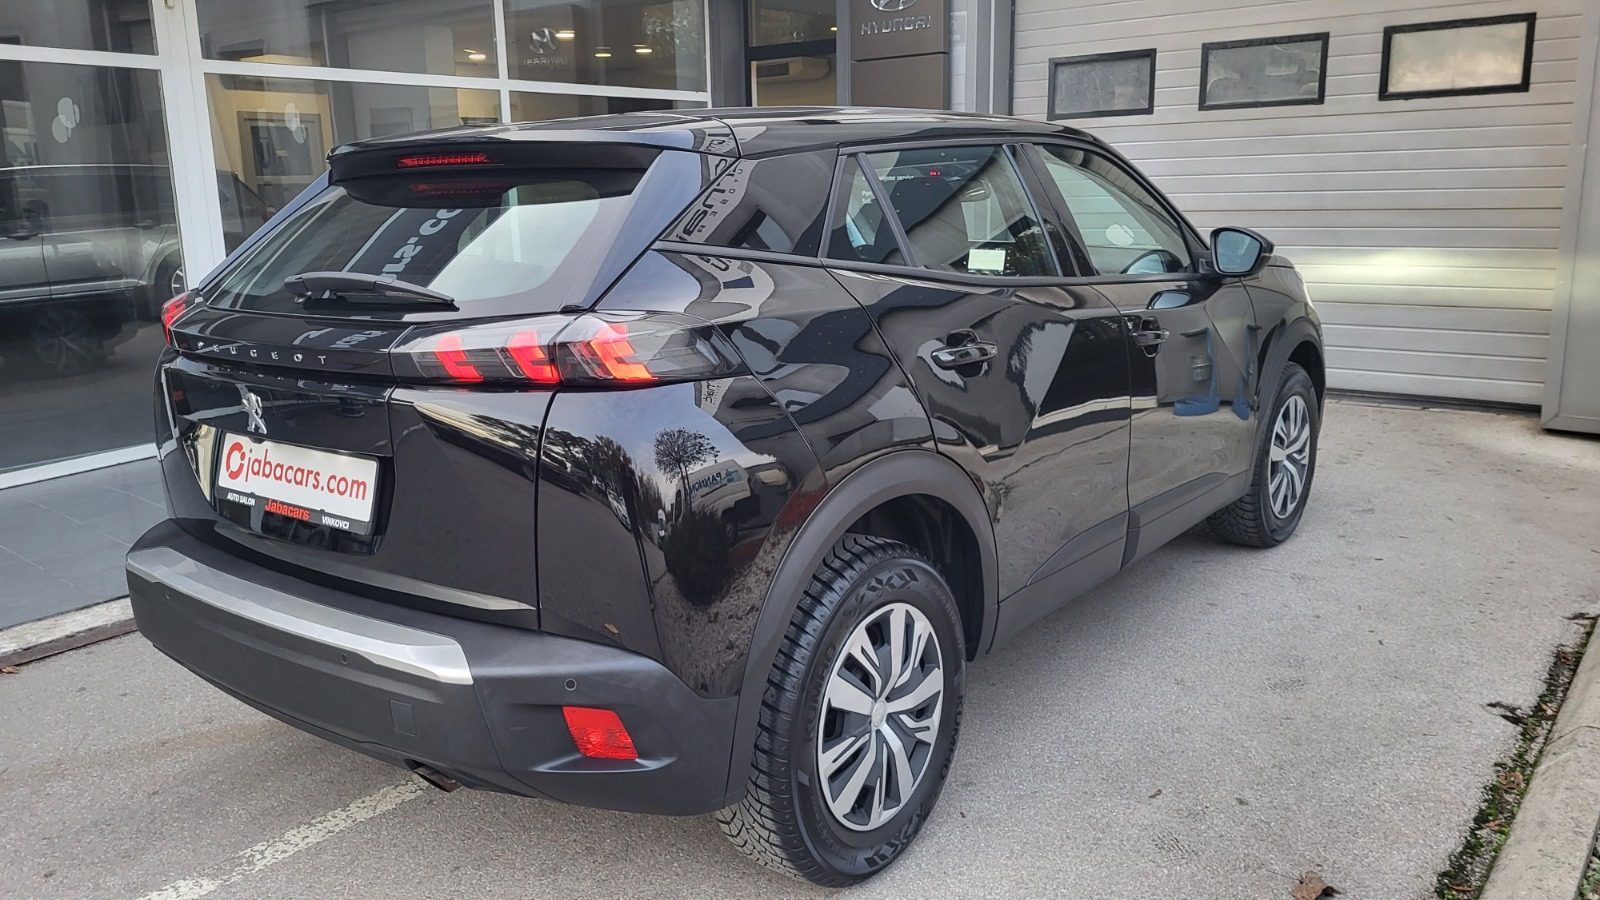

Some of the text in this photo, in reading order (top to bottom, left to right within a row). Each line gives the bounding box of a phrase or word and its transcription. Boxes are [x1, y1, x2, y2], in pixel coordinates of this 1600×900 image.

[860, 15, 931, 36] HYUNDAI
[196, 341, 326, 365] PEUGEOT
[226, 492, 255, 507] AUTO SALON
[264, 498, 310, 521] Jabacars
[321, 516, 350, 530] VINKOVCI
